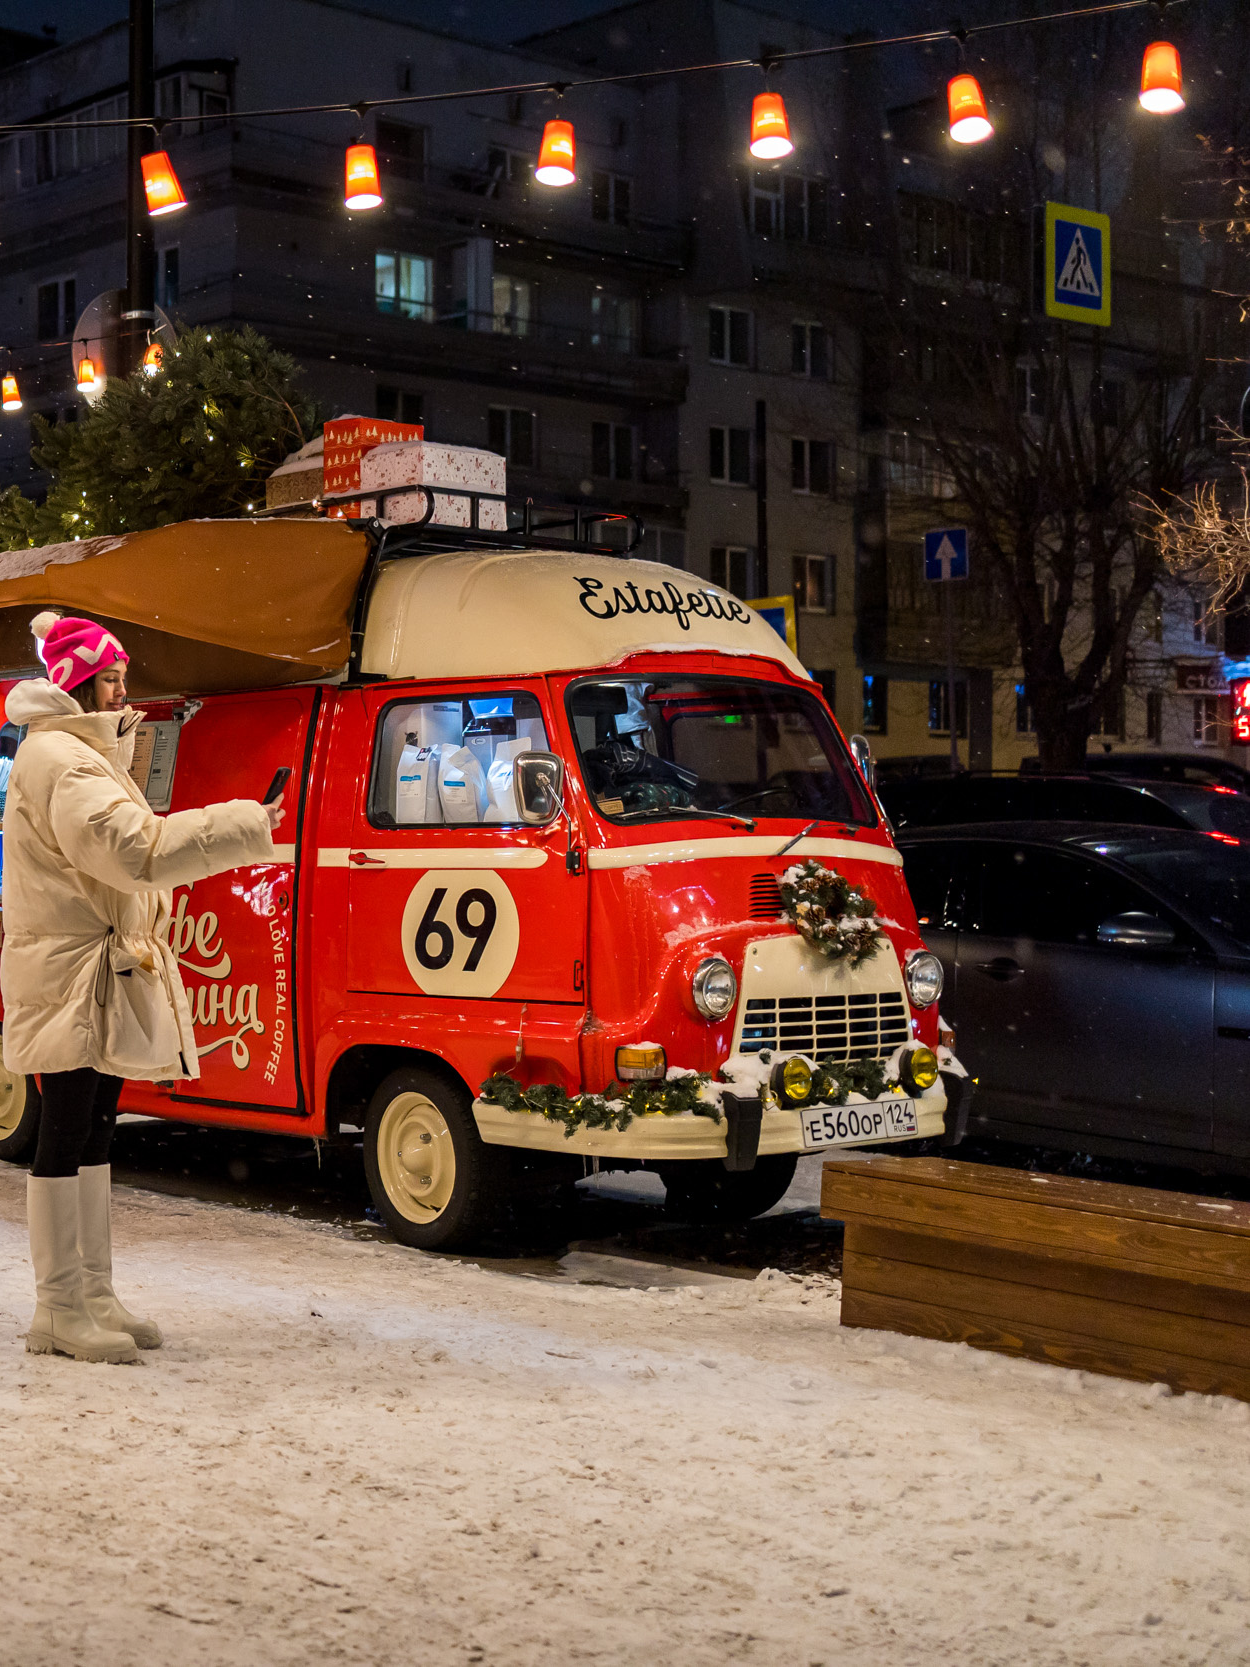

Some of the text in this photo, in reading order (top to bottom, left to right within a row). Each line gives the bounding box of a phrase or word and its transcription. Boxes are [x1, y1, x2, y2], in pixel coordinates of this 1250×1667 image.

[573, 577, 751, 630] Estafette
[269, 918, 285, 964] LOVE
[414, 887, 497, 972] 69
[275, 969, 286, 1015] REAL
[263, 1019, 285, 1085] COFFEE
[886, 1102, 914, 1125] 124
[893, 1125, 907, 1133] RUS
